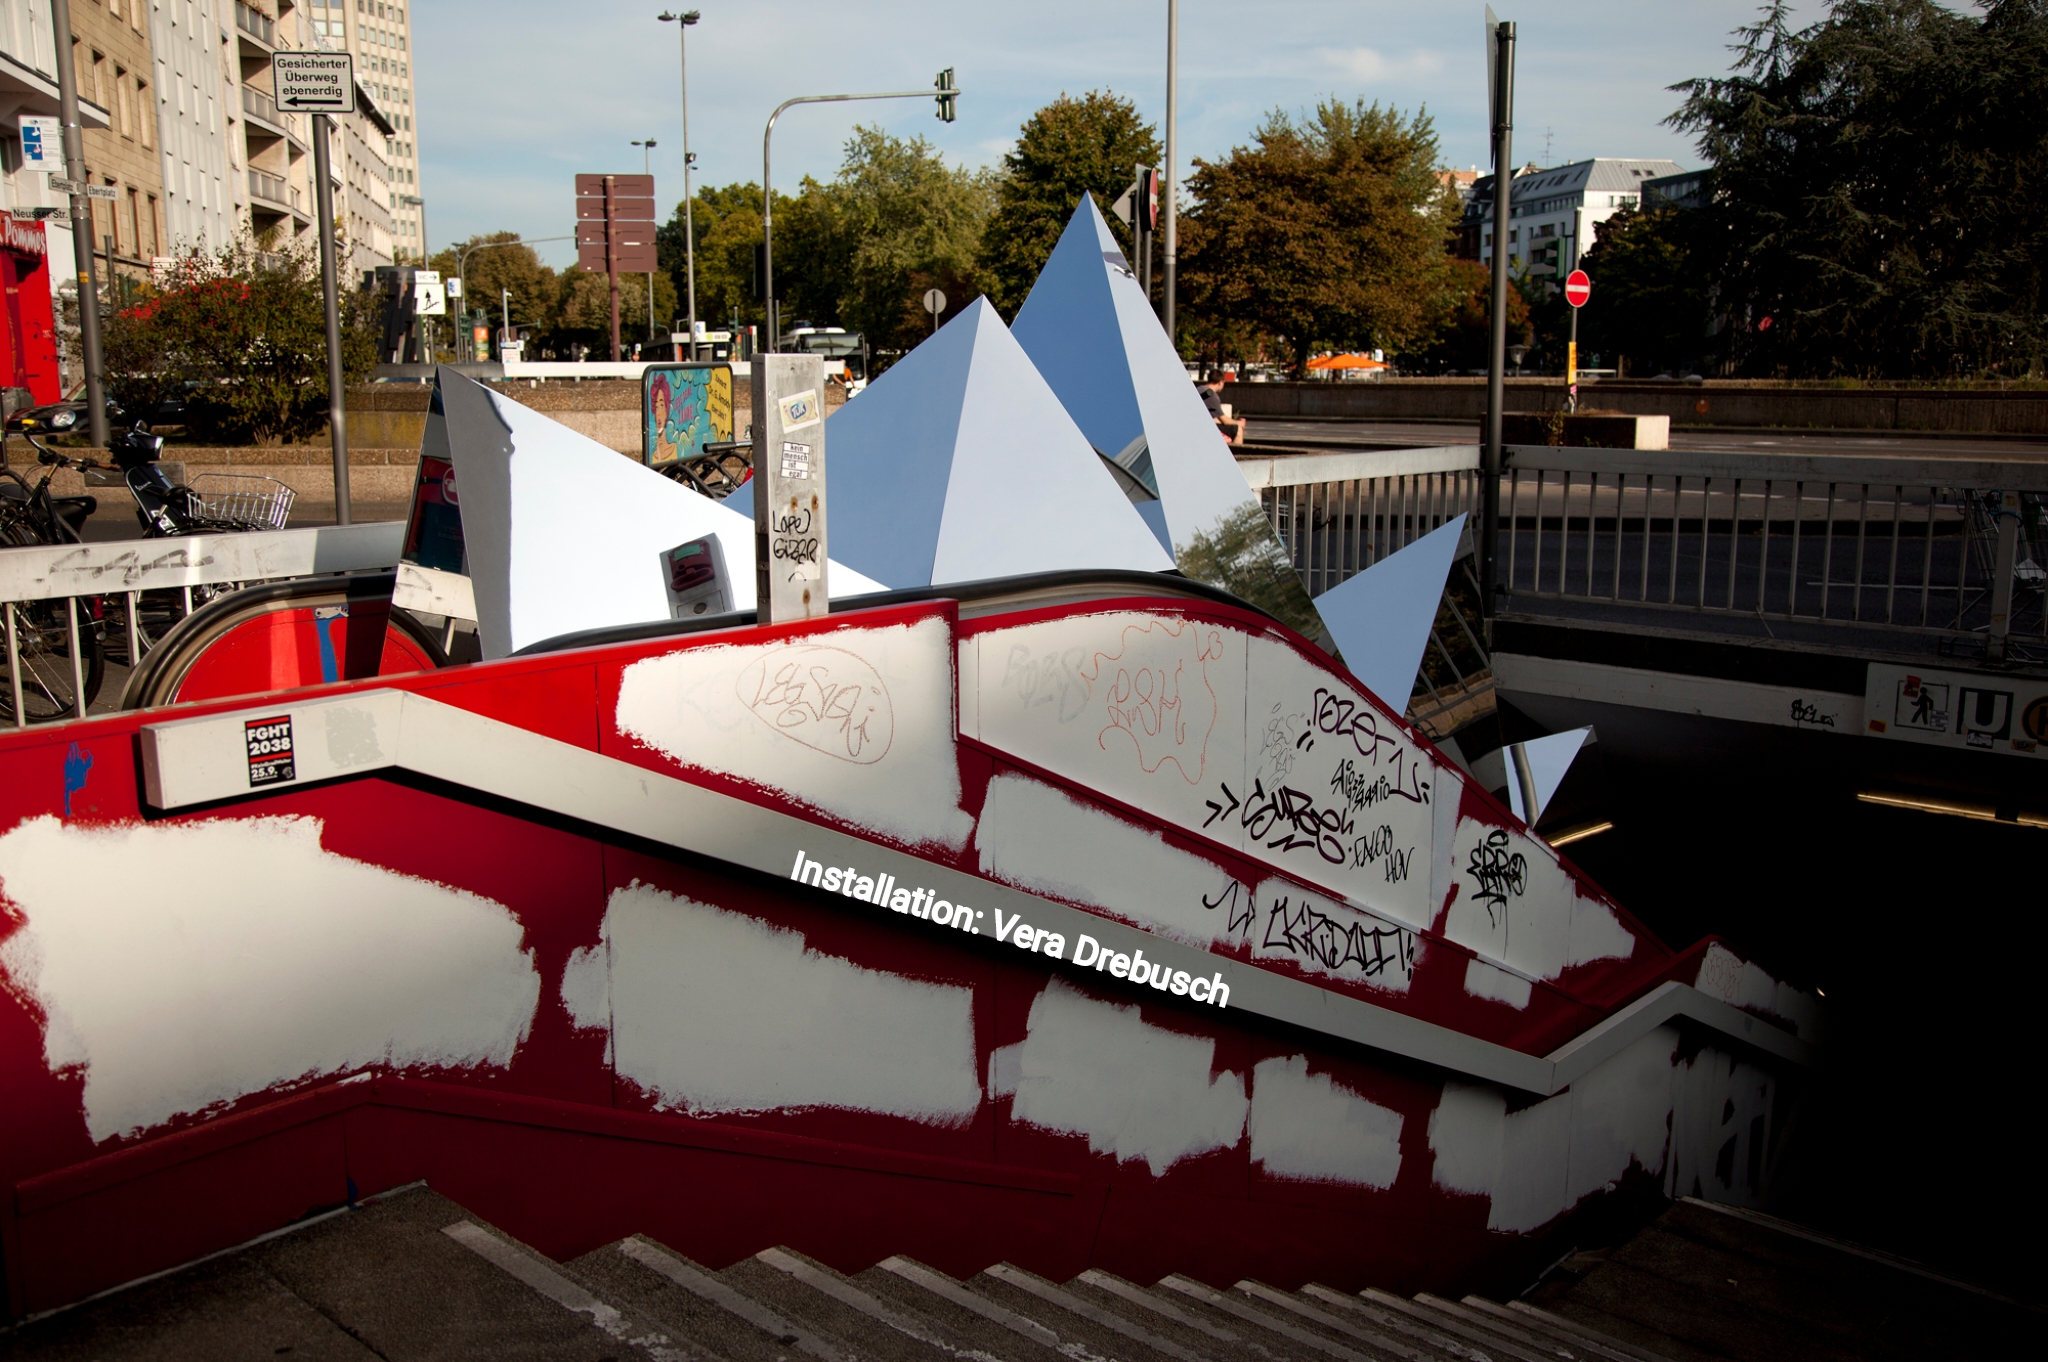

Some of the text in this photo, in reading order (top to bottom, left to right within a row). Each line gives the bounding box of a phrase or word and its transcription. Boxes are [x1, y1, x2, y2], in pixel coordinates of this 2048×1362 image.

[277, 58, 347, 69] Gesicherter
[285, 70, 338, 84] Überweg
[282, 86, 343, 97] ebenerdig
[51, 178, 74, 192] Ebertplatz
[88, 185, 116, 197] Ebertplatz
[13, 209, 69, 219] Neusser Str.
[4, 214, 46, 256] Pommes
[790, 443, 804, 452] kein
[783, 452, 808, 462] mensch
[787, 460, 797, 468] ist
[788, 470, 803, 478] egal
[1963, 691, 2008, 732] U
[247, 723, 290, 742] FGHT
[249, 737, 291, 756] 2038
[252, 766, 278, 779] 25.9.
